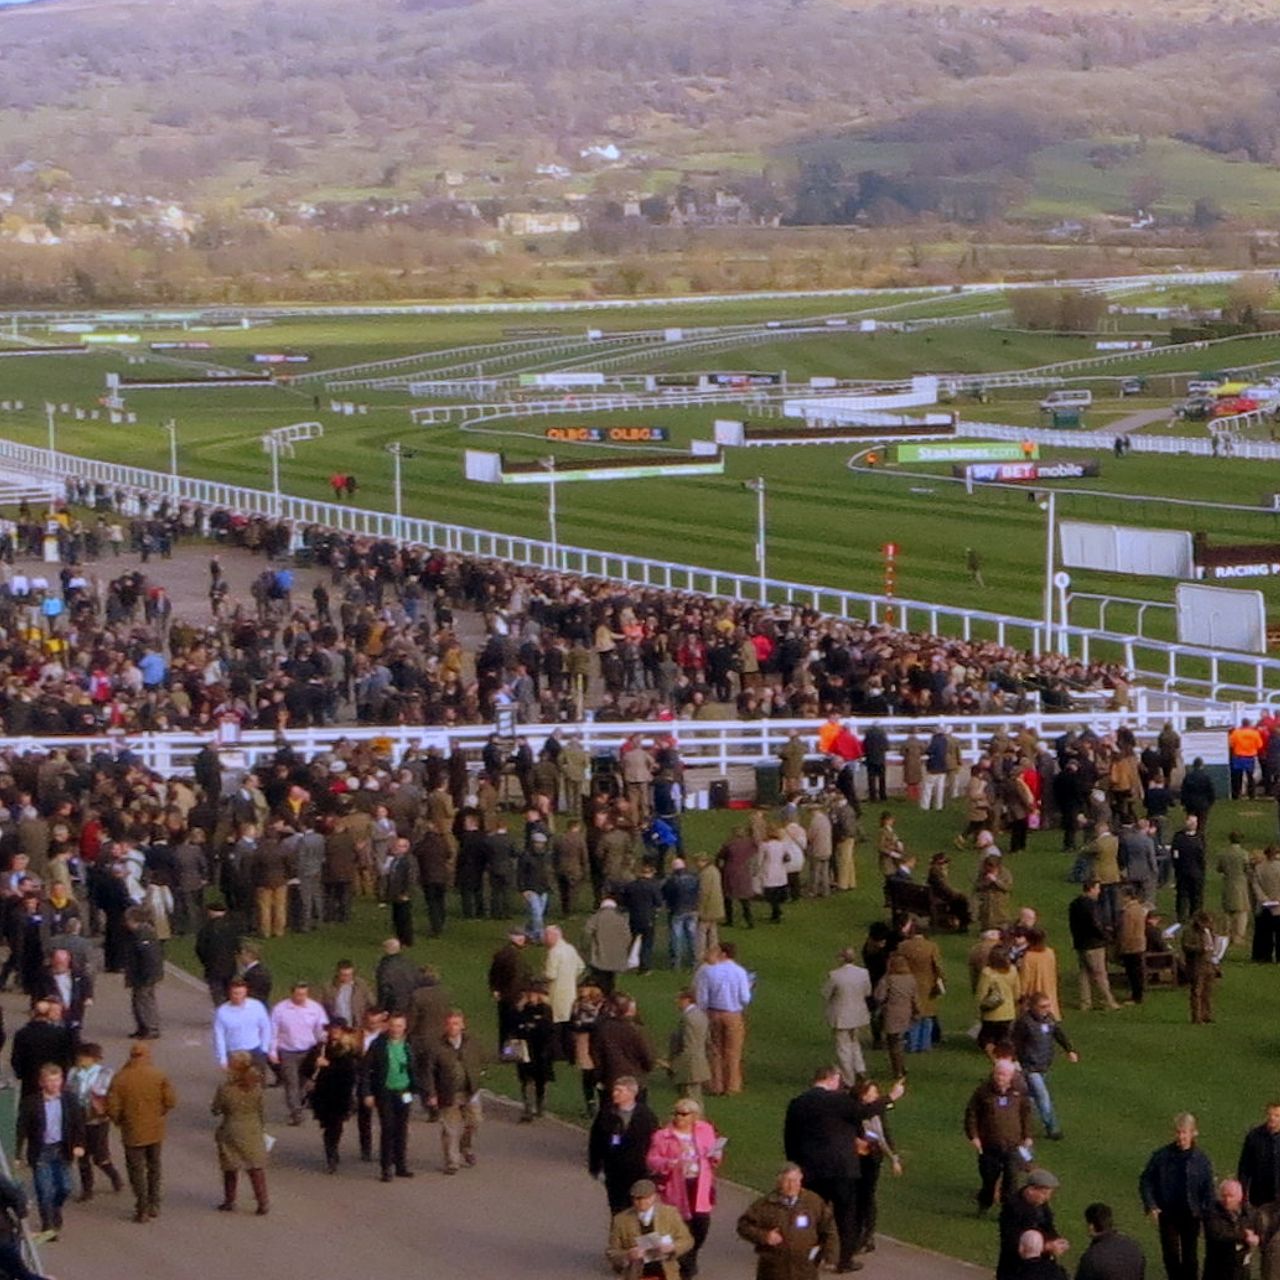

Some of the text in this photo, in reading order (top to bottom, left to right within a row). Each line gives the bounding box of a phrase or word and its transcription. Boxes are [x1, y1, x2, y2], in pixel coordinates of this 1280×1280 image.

[547, 427, 588, 440] OLBG
[609, 427, 650, 441] OLBG
[1038, 461, 1084, 478] mobile
[1215, 565, 1269, 578] RACING
